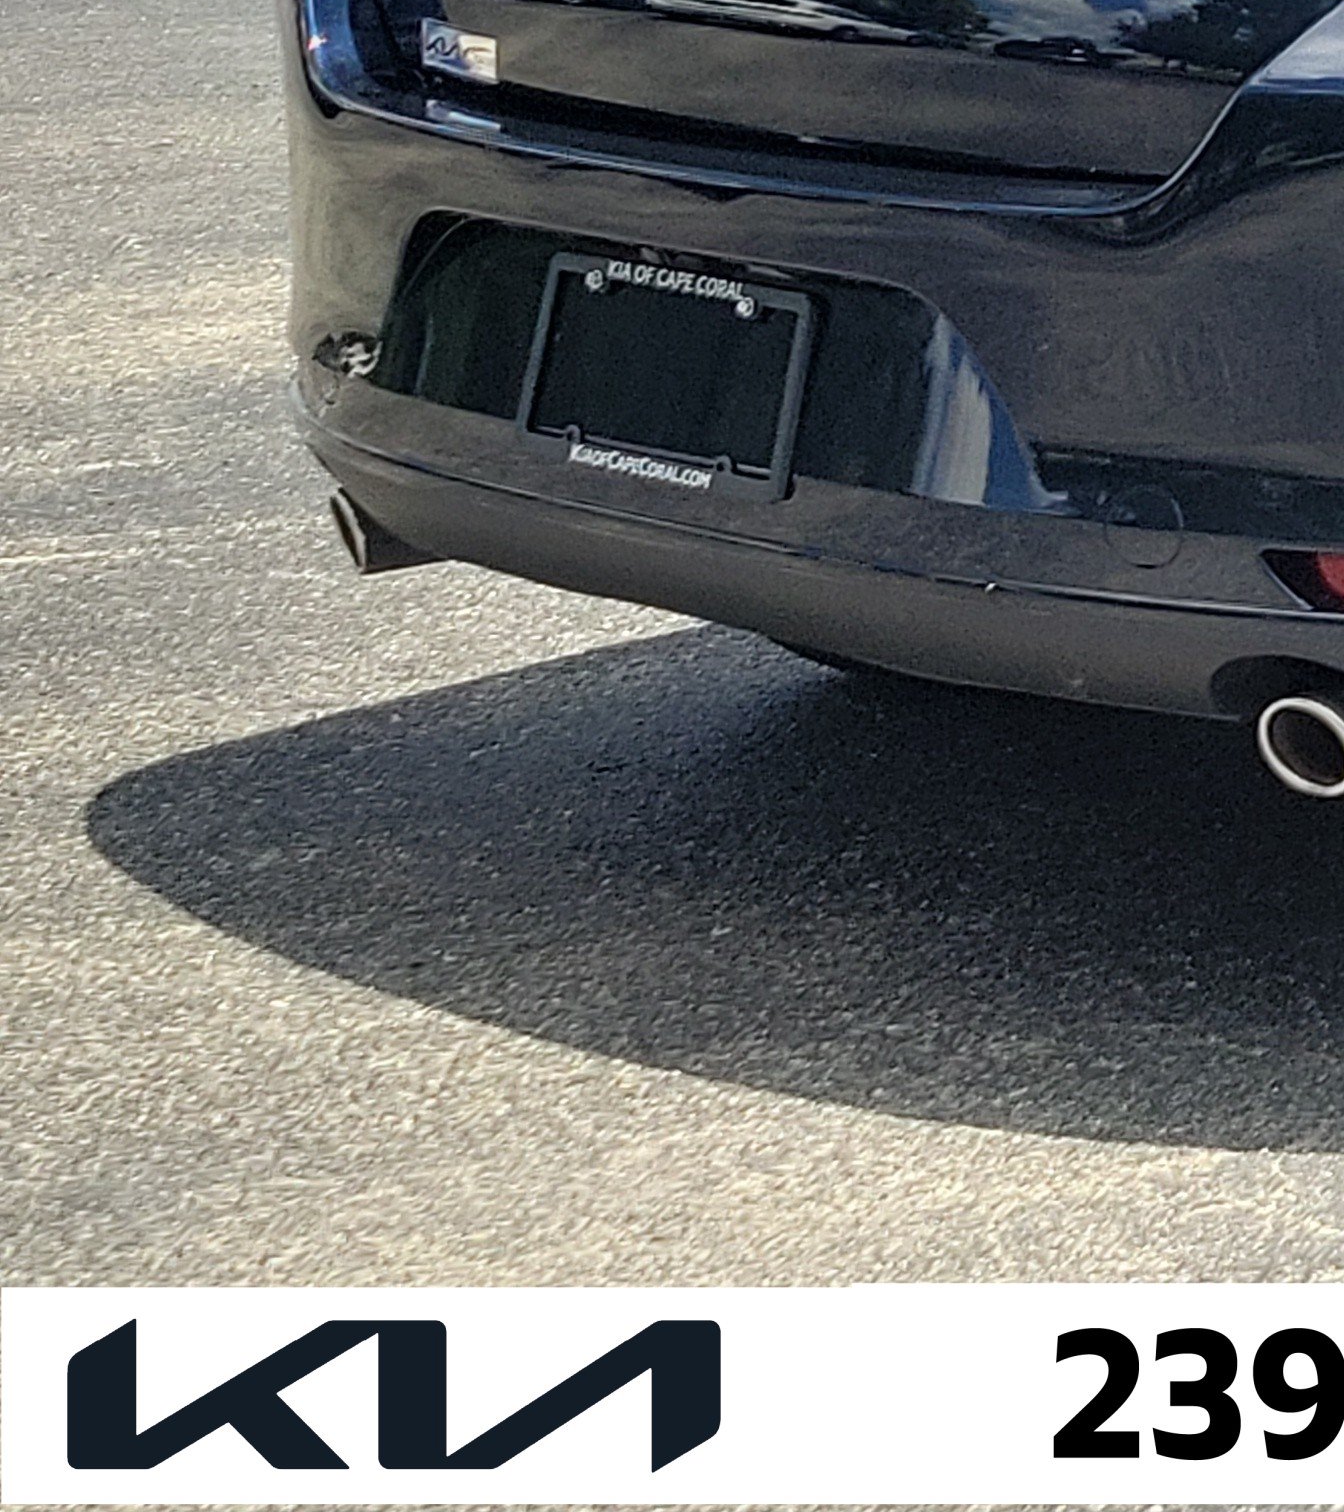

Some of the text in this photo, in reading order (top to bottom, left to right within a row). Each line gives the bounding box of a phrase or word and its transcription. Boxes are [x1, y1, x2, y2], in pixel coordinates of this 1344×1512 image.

[606, 259, 745, 301] KIA OF CAPE CORAL
